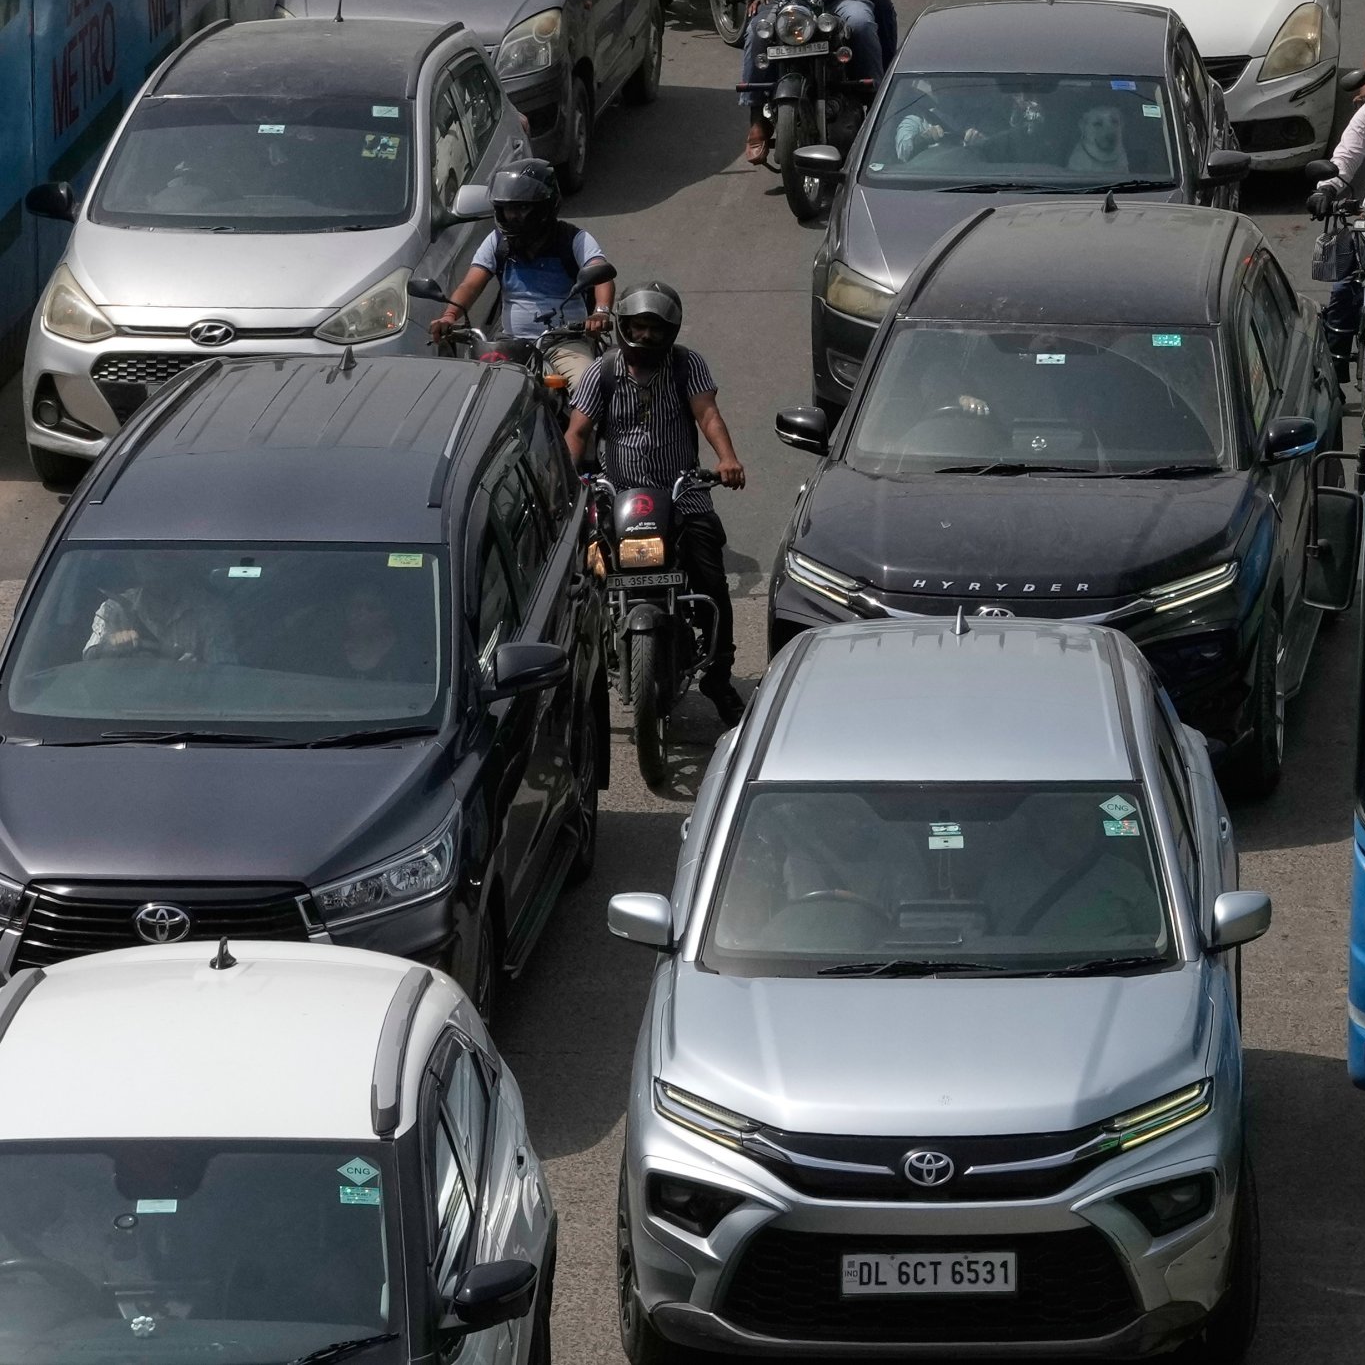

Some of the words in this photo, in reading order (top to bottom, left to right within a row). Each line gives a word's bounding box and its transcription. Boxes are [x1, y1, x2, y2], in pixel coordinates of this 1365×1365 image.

[53, 1, 117, 143] METRO
[913, 579, 1089, 592] HYRYDER
[1107, 801, 1133, 813] CNG
[346, 1164, 371, 1177] CNG
[859, 1261, 888, 1286] DL
[897, 1261, 941, 1285] 6CT
[951, 1260, 1009, 1285] 6531
